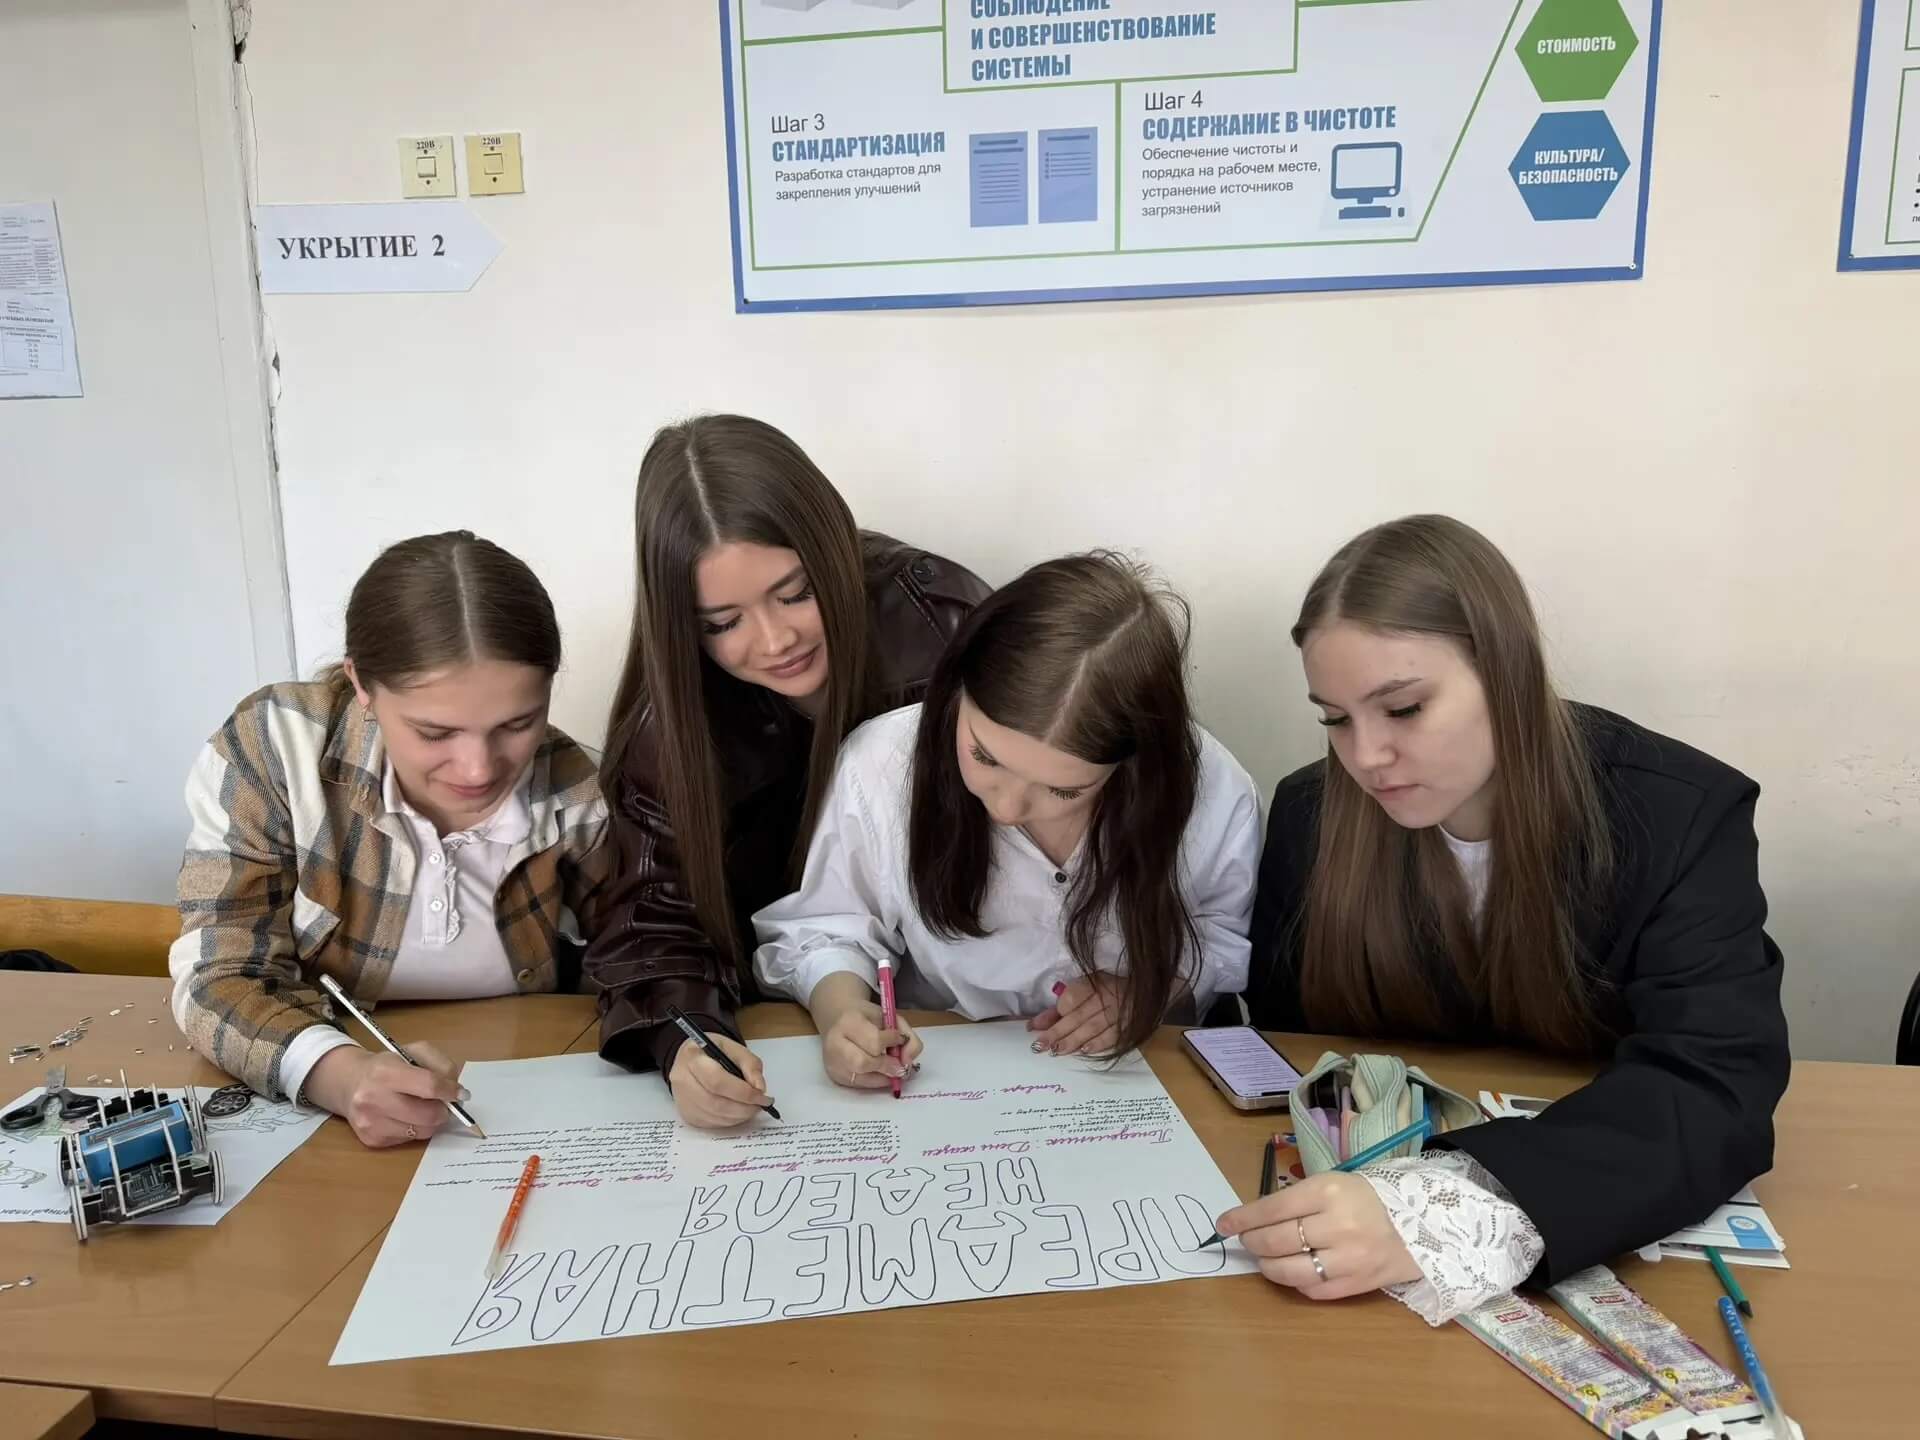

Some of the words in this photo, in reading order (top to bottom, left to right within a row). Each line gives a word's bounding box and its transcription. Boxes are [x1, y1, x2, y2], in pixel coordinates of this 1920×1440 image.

[971, 28, 984, 50] И
[988, 13, 1217, 49] СОВЕРШЕНСТВОВАНИЕ
[1536, 36, 1617, 55] СТОИМОСТЬ
[971, 54, 1072, 81] СИСТЕМЫ
[1144, 92, 1187, 111] Шаг
[1191, 90, 1204, 108] 4
[771, 115, 809, 134] Шаг
[813, 113, 826, 131] 3
[1142, 112, 1281, 142] СОДЕРЖАНИЕ
[1285, 111, 1299, 133] В
[1303, 106, 1397, 132] ЧИСТОТЕ
[772, 131, 946, 163] СТАНДАРТИЗАЦИЯ
[1142, 146, 1230, 161] Обеспечение
[1232, 144, 1287, 157] чистоты
[1290, 144, 1299, 153] и
[1534, 147, 1606, 165] КУЛЬТУРА/
[775, 169, 843, 184] Разработка
[846, 165, 916, 179] стандартов
[918, 164, 942, 176] для
[1141, 166, 1195, 180] порядка
[1199, 166, 1214, 177] на
[1217, 162, 1275, 178] рабочем
[1278, 160, 1321, 173] месте,
[1518, 167, 1619, 185] БЕЗОПАСНОСТЬ
[776, 186, 851, 202] закрепления
[853, 181, 921, 199] улучшений
[1141, 184, 1217, 200] устранение
[1220, 181, 1294, 194] источников
[1141, 202, 1222, 218] загрязнений
[276, 235, 418, 261] УКРЫТИЕ
[431, 233, 446, 257] 2
[921, 1144, 976, 1158] сказки
[980, 1140, 1032, 1154] День
[680, 1155, 1045, 1238] НЕДЕЛЯ
